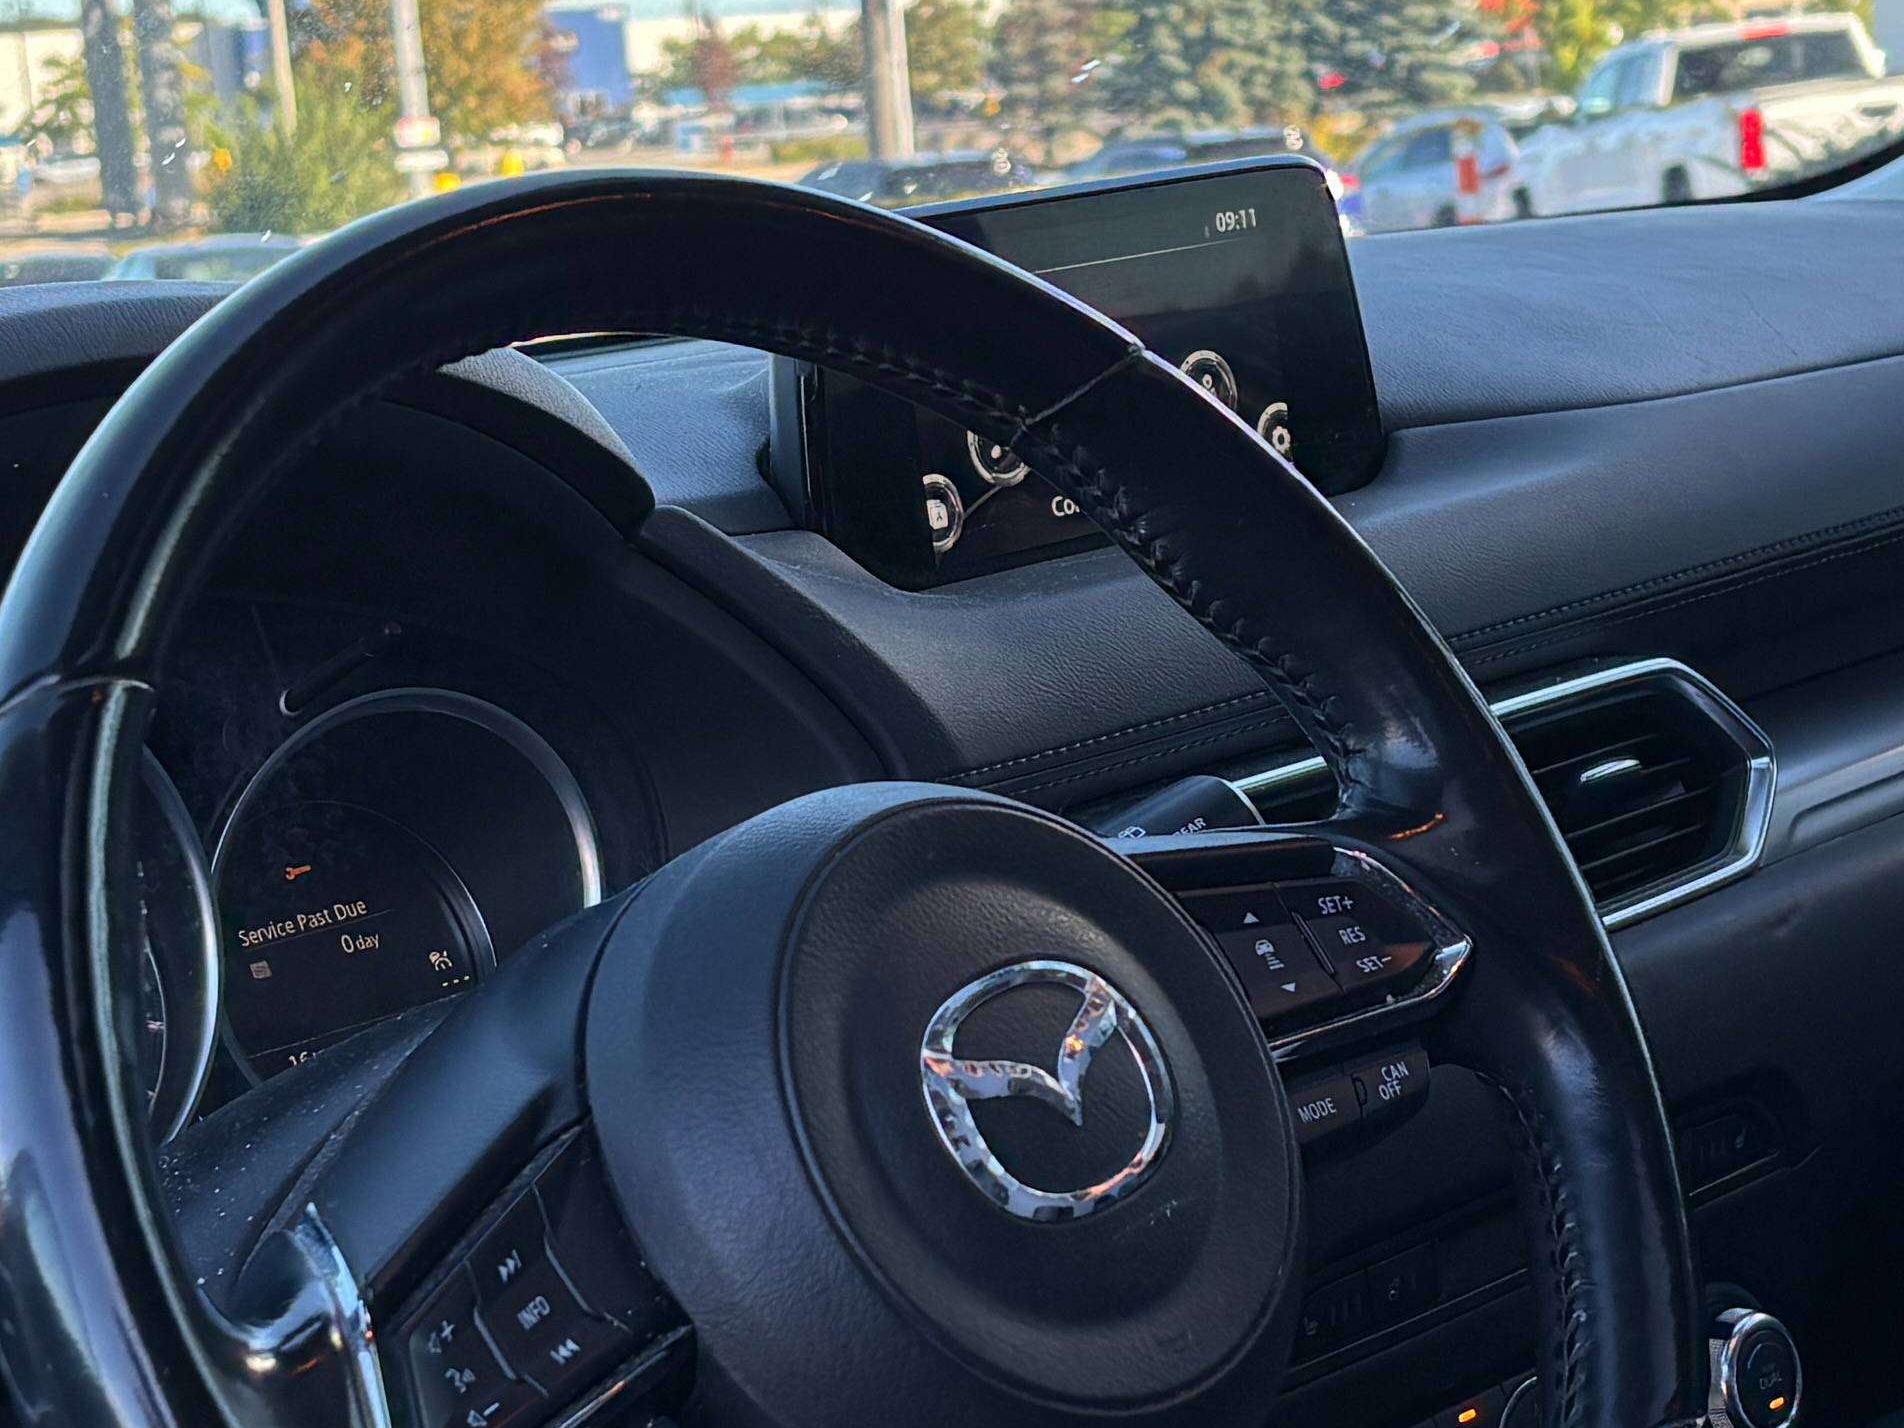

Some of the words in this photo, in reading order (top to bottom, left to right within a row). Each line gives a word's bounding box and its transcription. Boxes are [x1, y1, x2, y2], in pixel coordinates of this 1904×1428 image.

[1215, 207, 1257, 233] 09:11
[1050, 494, 1080, 517] Co
[238, 919, 296, 948] Service
[296, 908, 332, 932] Past
[333, 899, 368, 922] Due
[1338, 925, 1367, 946] RES
[340, 933, 355, 955] 0
[355, 931, 381, 951] day
[1380, 1060, 1410, 1082] CAN
[1377, 1079, 1402, 1101] OFF
[1297, 1097, 1336, 1124] MODE
[517, 1295, 551, 1331] INFO
